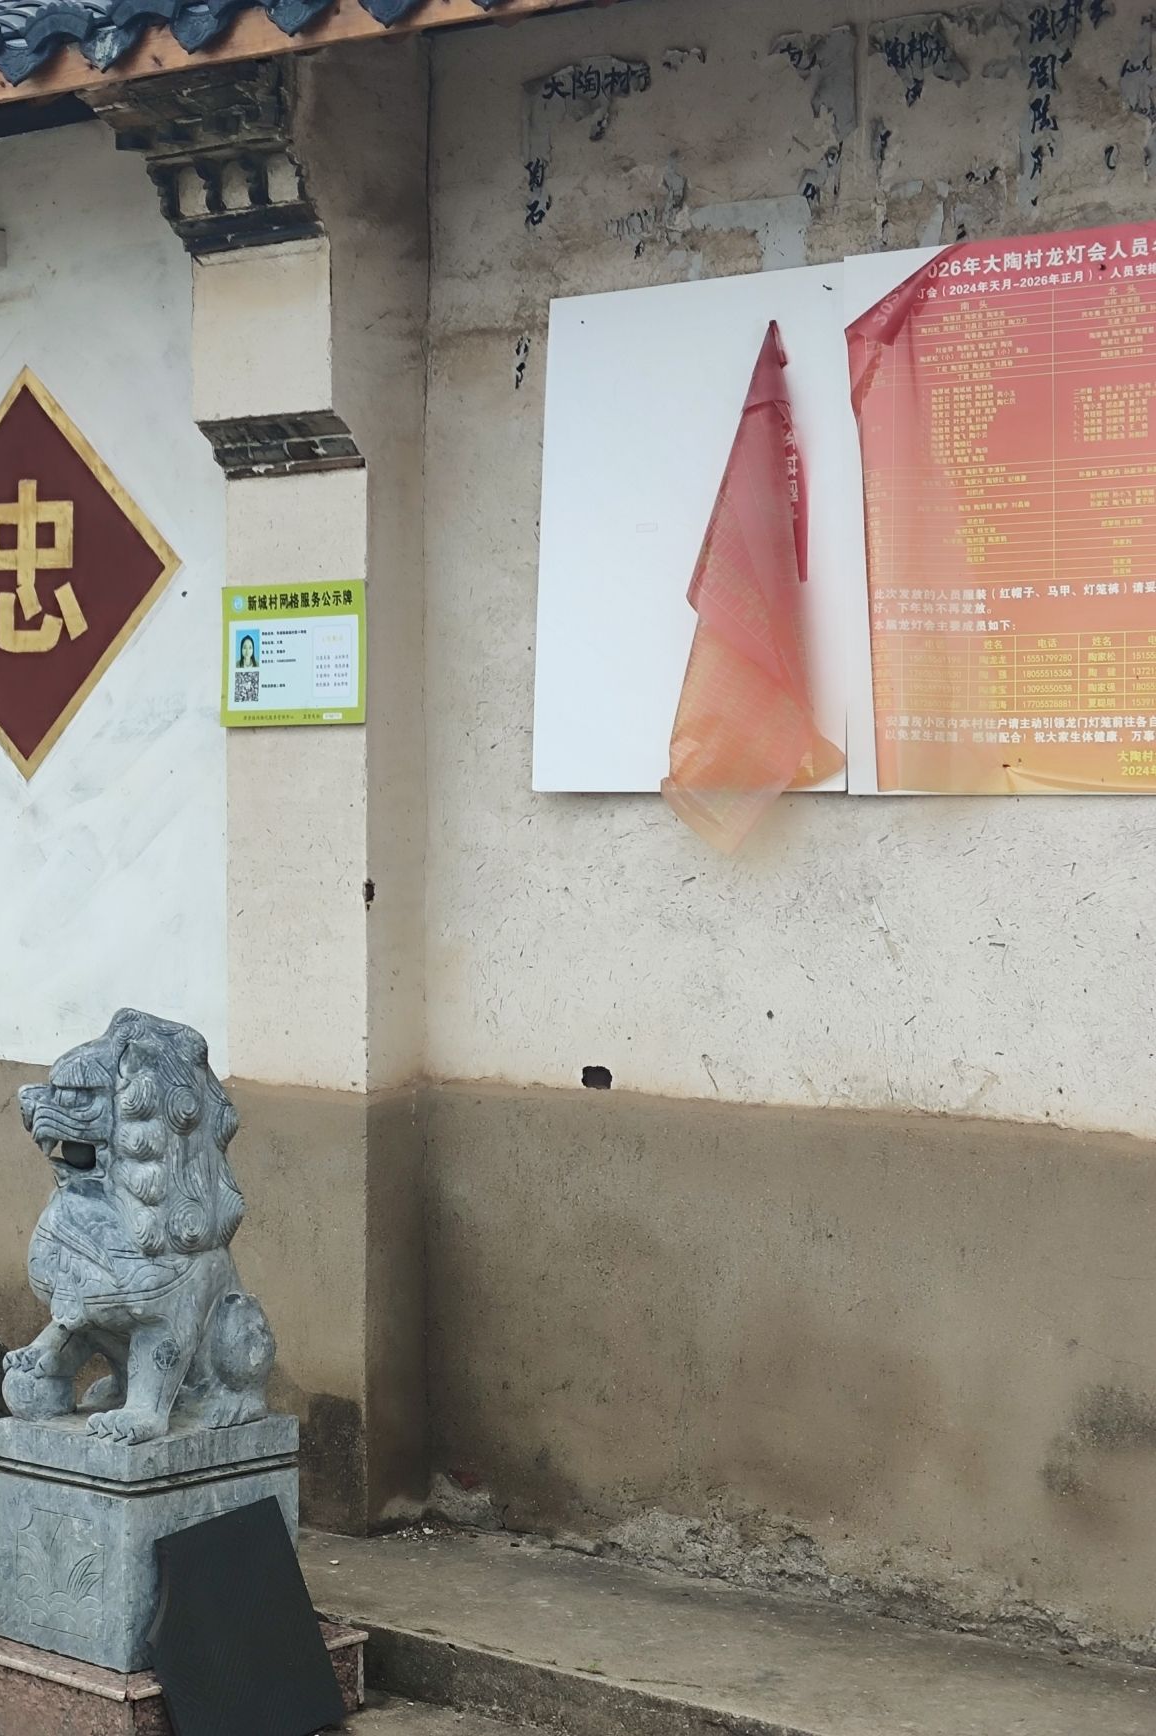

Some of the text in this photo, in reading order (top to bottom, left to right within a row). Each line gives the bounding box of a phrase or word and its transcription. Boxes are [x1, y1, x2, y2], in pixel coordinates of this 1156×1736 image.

[247, 589, 353, 611] 新城村网格服务公示牌
